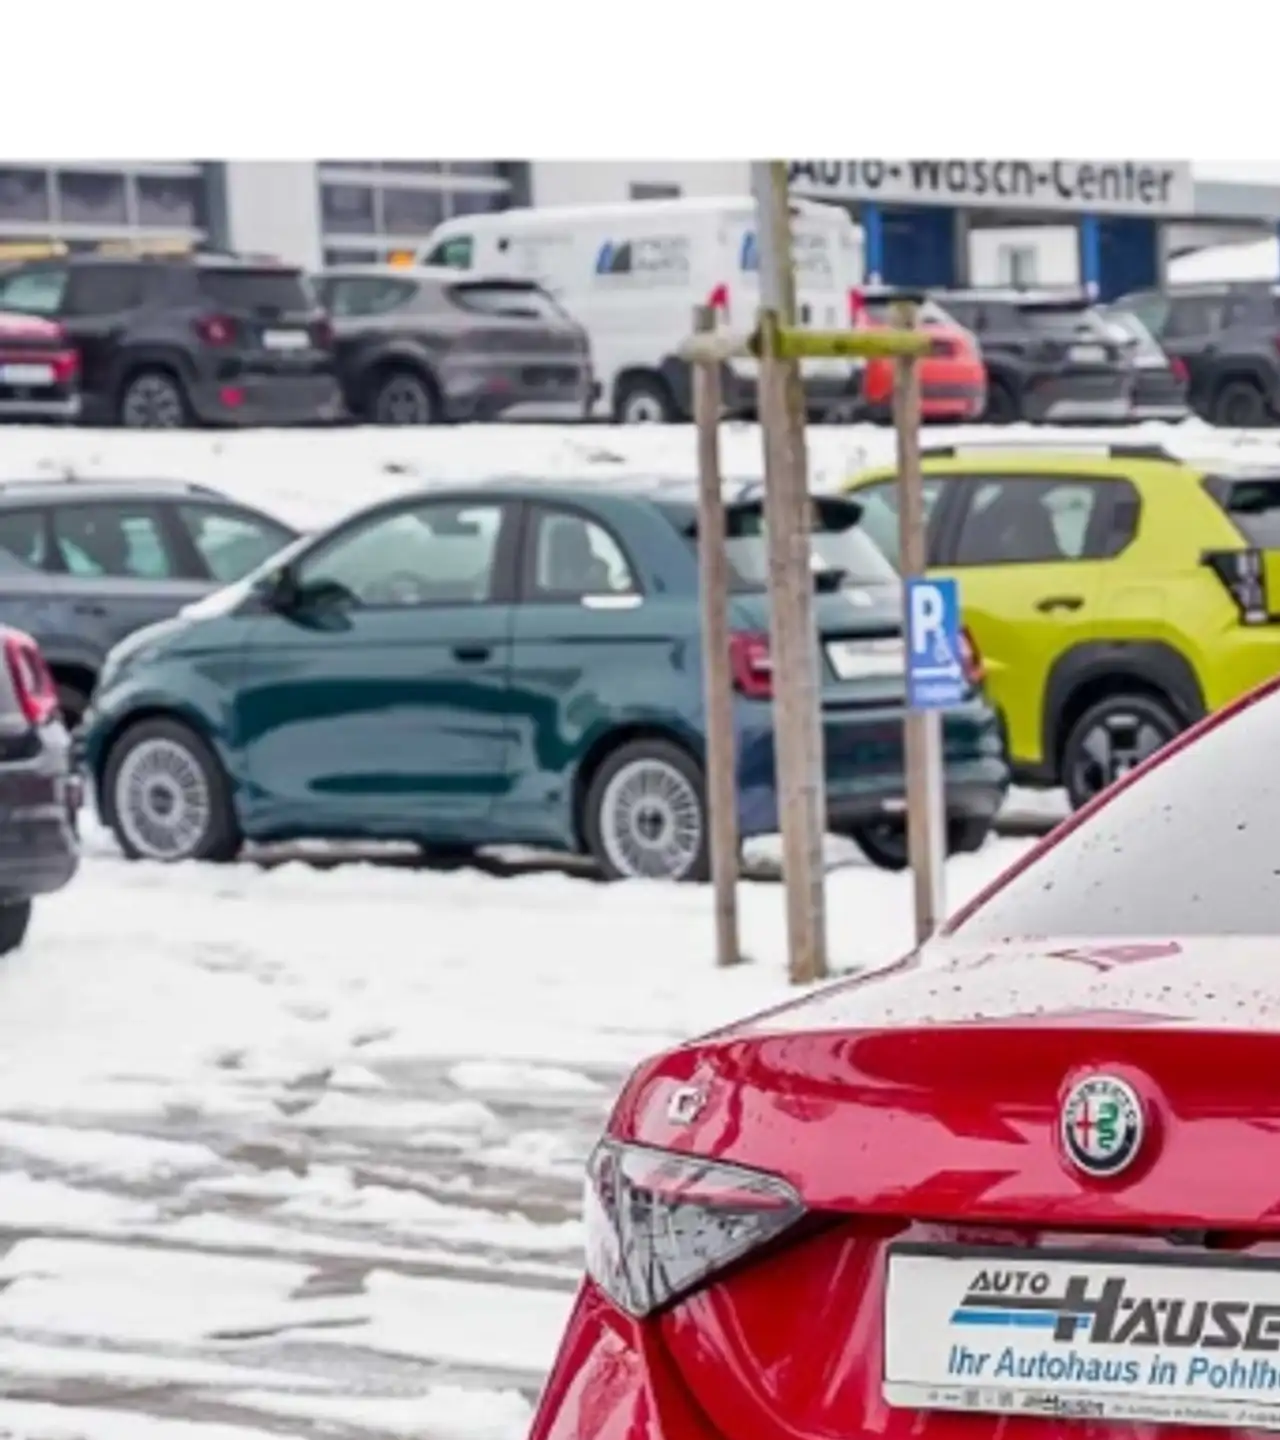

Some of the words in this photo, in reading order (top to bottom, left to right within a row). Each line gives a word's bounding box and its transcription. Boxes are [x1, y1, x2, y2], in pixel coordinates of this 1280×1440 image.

[969, 1269, 1051, 1295] AUTO
[947, 1344, 988, 1376] Ihr
[994, 1346, 1139, 1384] Autohaus
[1149, 1353, 1177, 1385] in
